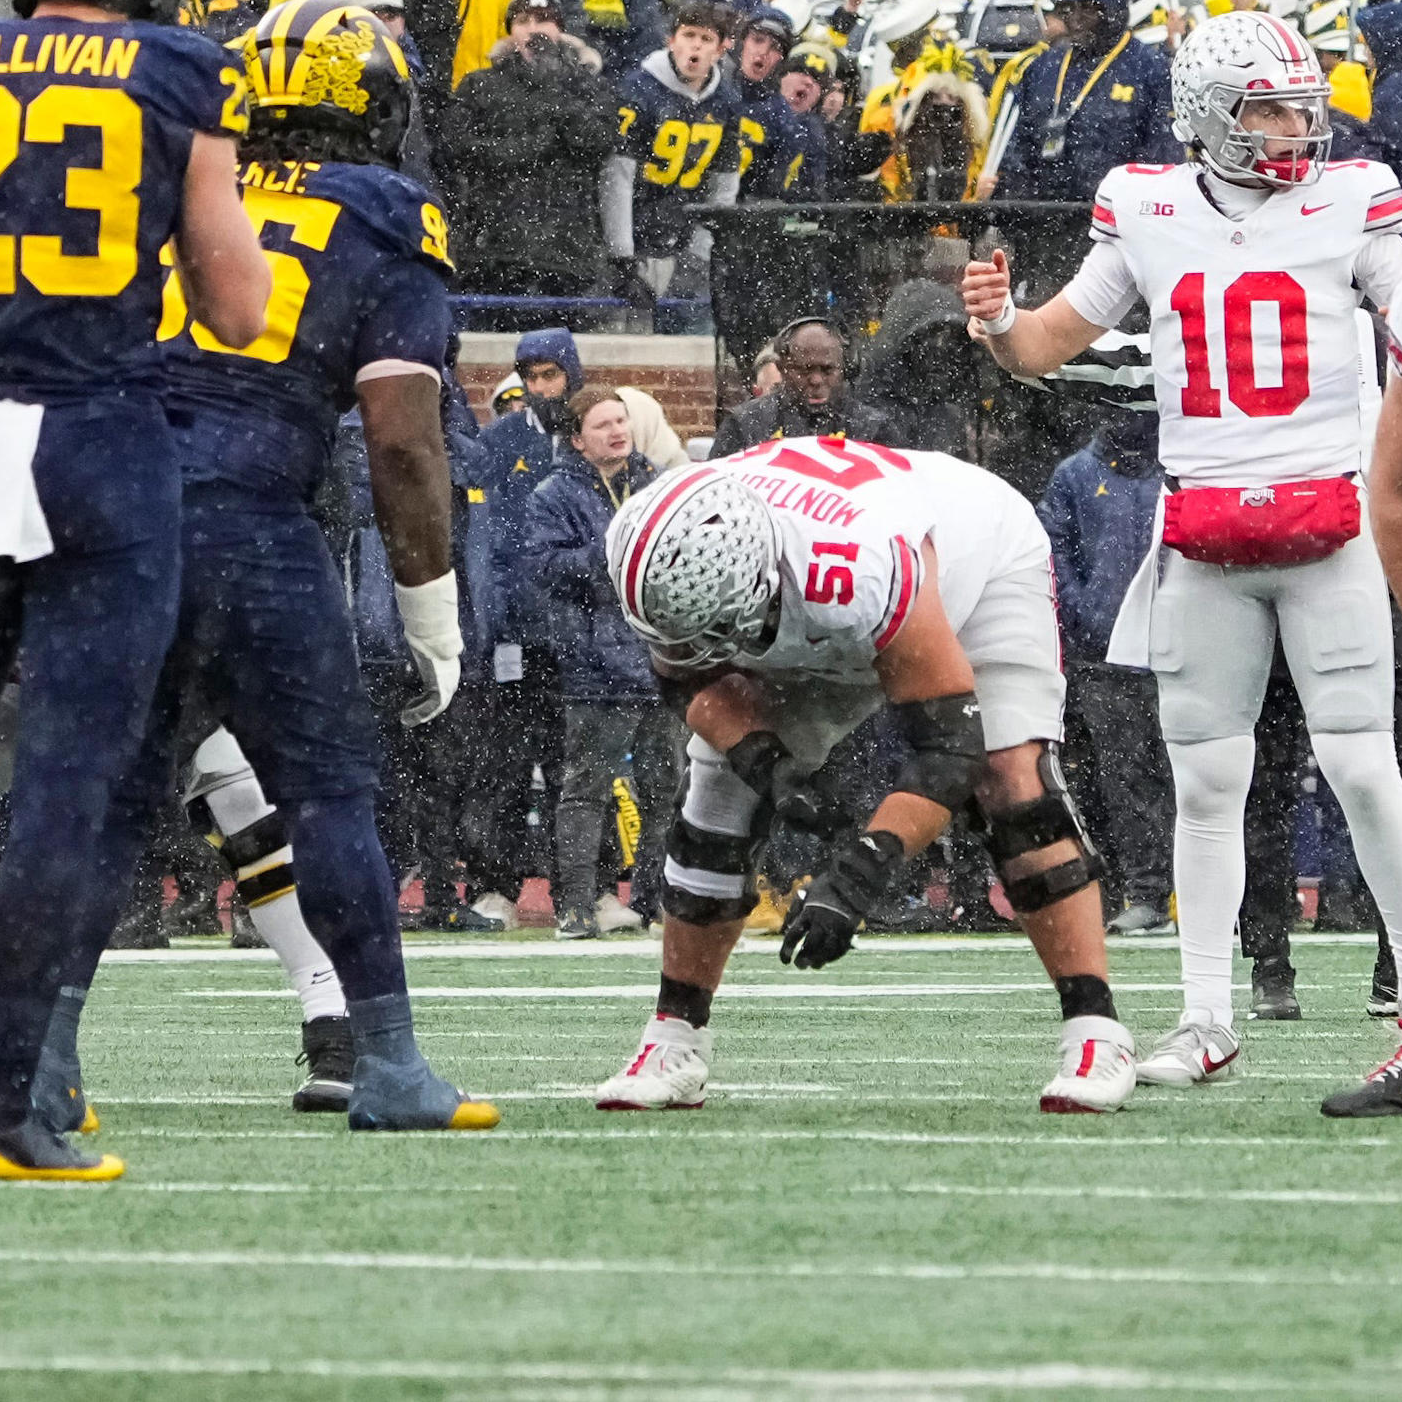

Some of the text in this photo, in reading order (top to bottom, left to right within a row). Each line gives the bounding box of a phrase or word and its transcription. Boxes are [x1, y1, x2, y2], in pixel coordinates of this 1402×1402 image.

[1113, 86, 1132, 100] M
[642, 121, 722, 189] 97
[155, 193, 342, 364] 5
[1170, 271, 1311, 420] 10
[467, 488, 485, 503] M
[804, 541, 861, 607] 51
